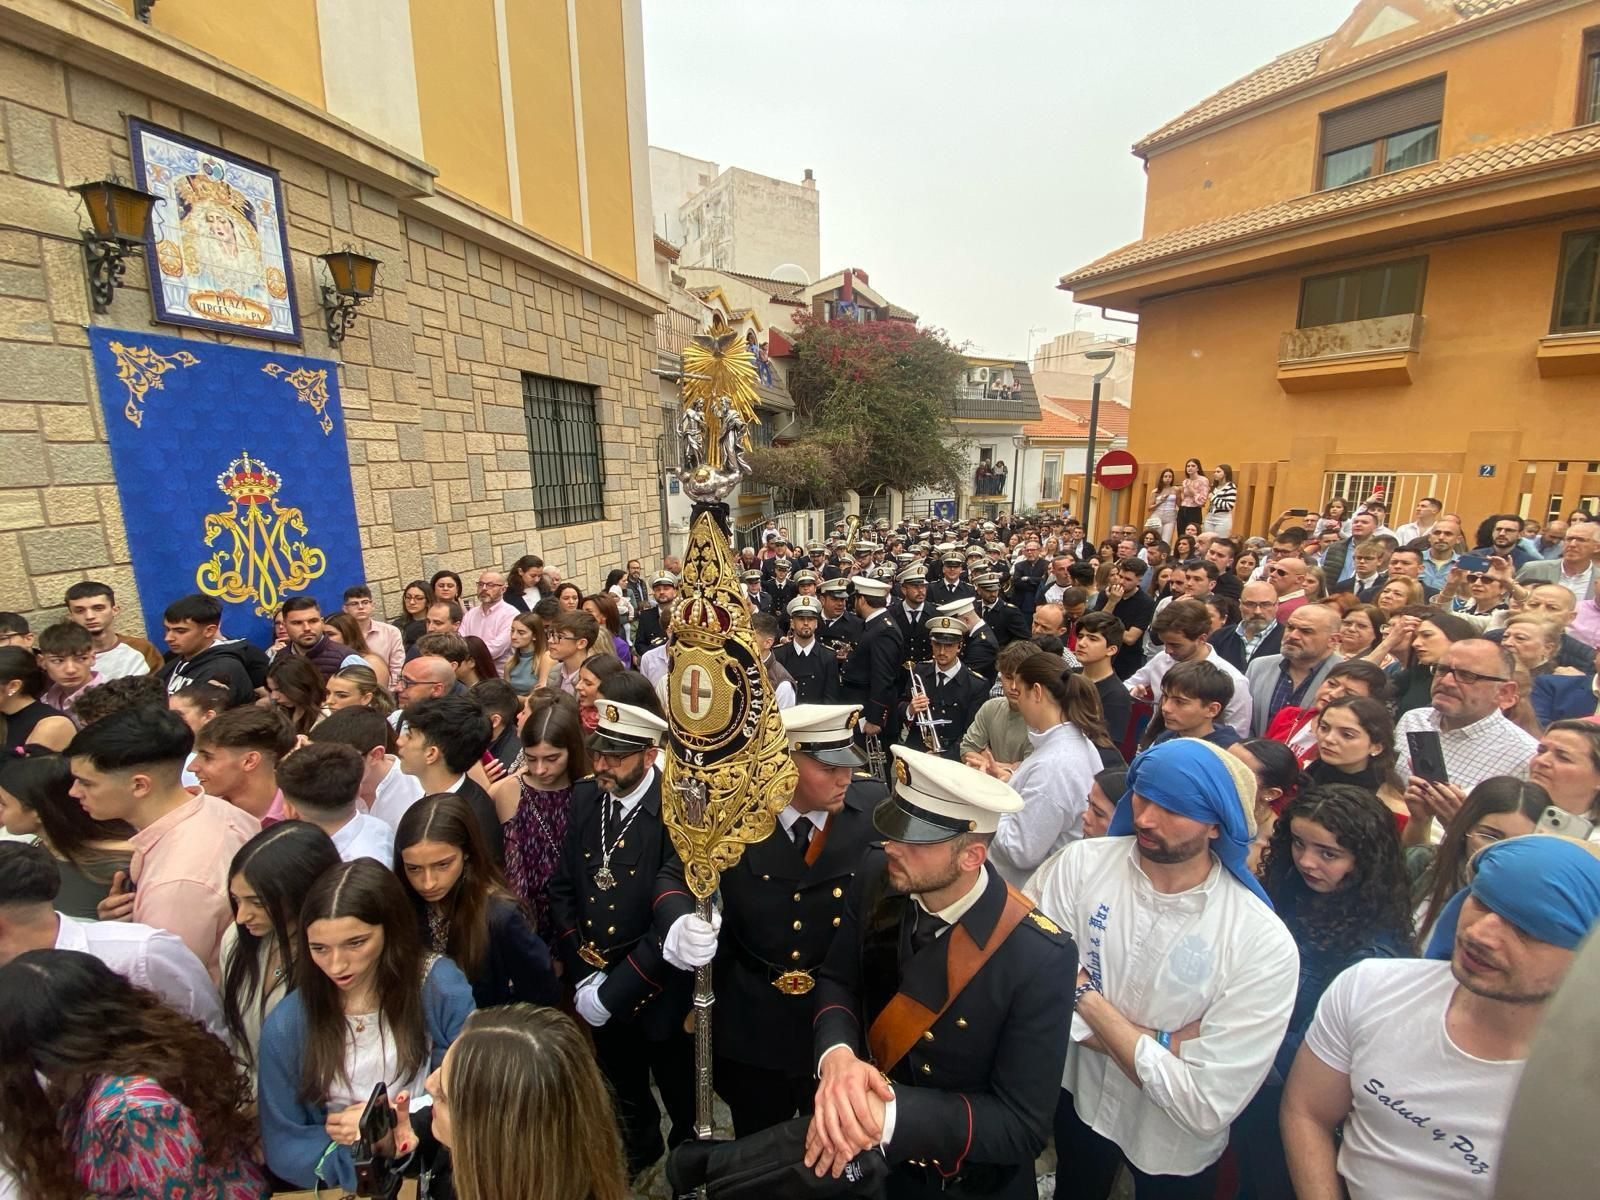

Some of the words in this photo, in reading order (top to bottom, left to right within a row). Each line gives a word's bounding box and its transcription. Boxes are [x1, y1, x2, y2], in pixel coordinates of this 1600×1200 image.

[196, 301, 231, 316] VIRGEN
[216, 295, 247, 311] PLAZA
[1483, 466, 1491, 476] 2
[685, 749, 704, 766] DE
[743, 663, 763, 738] GRACIA
[1088, 903, 1110, 931] Paz
[1363, 1078, 1431, 1128] Salud
[1433, 1128, 1447, 1141] y
[1449, 1135, 1489, 1174] Paz
